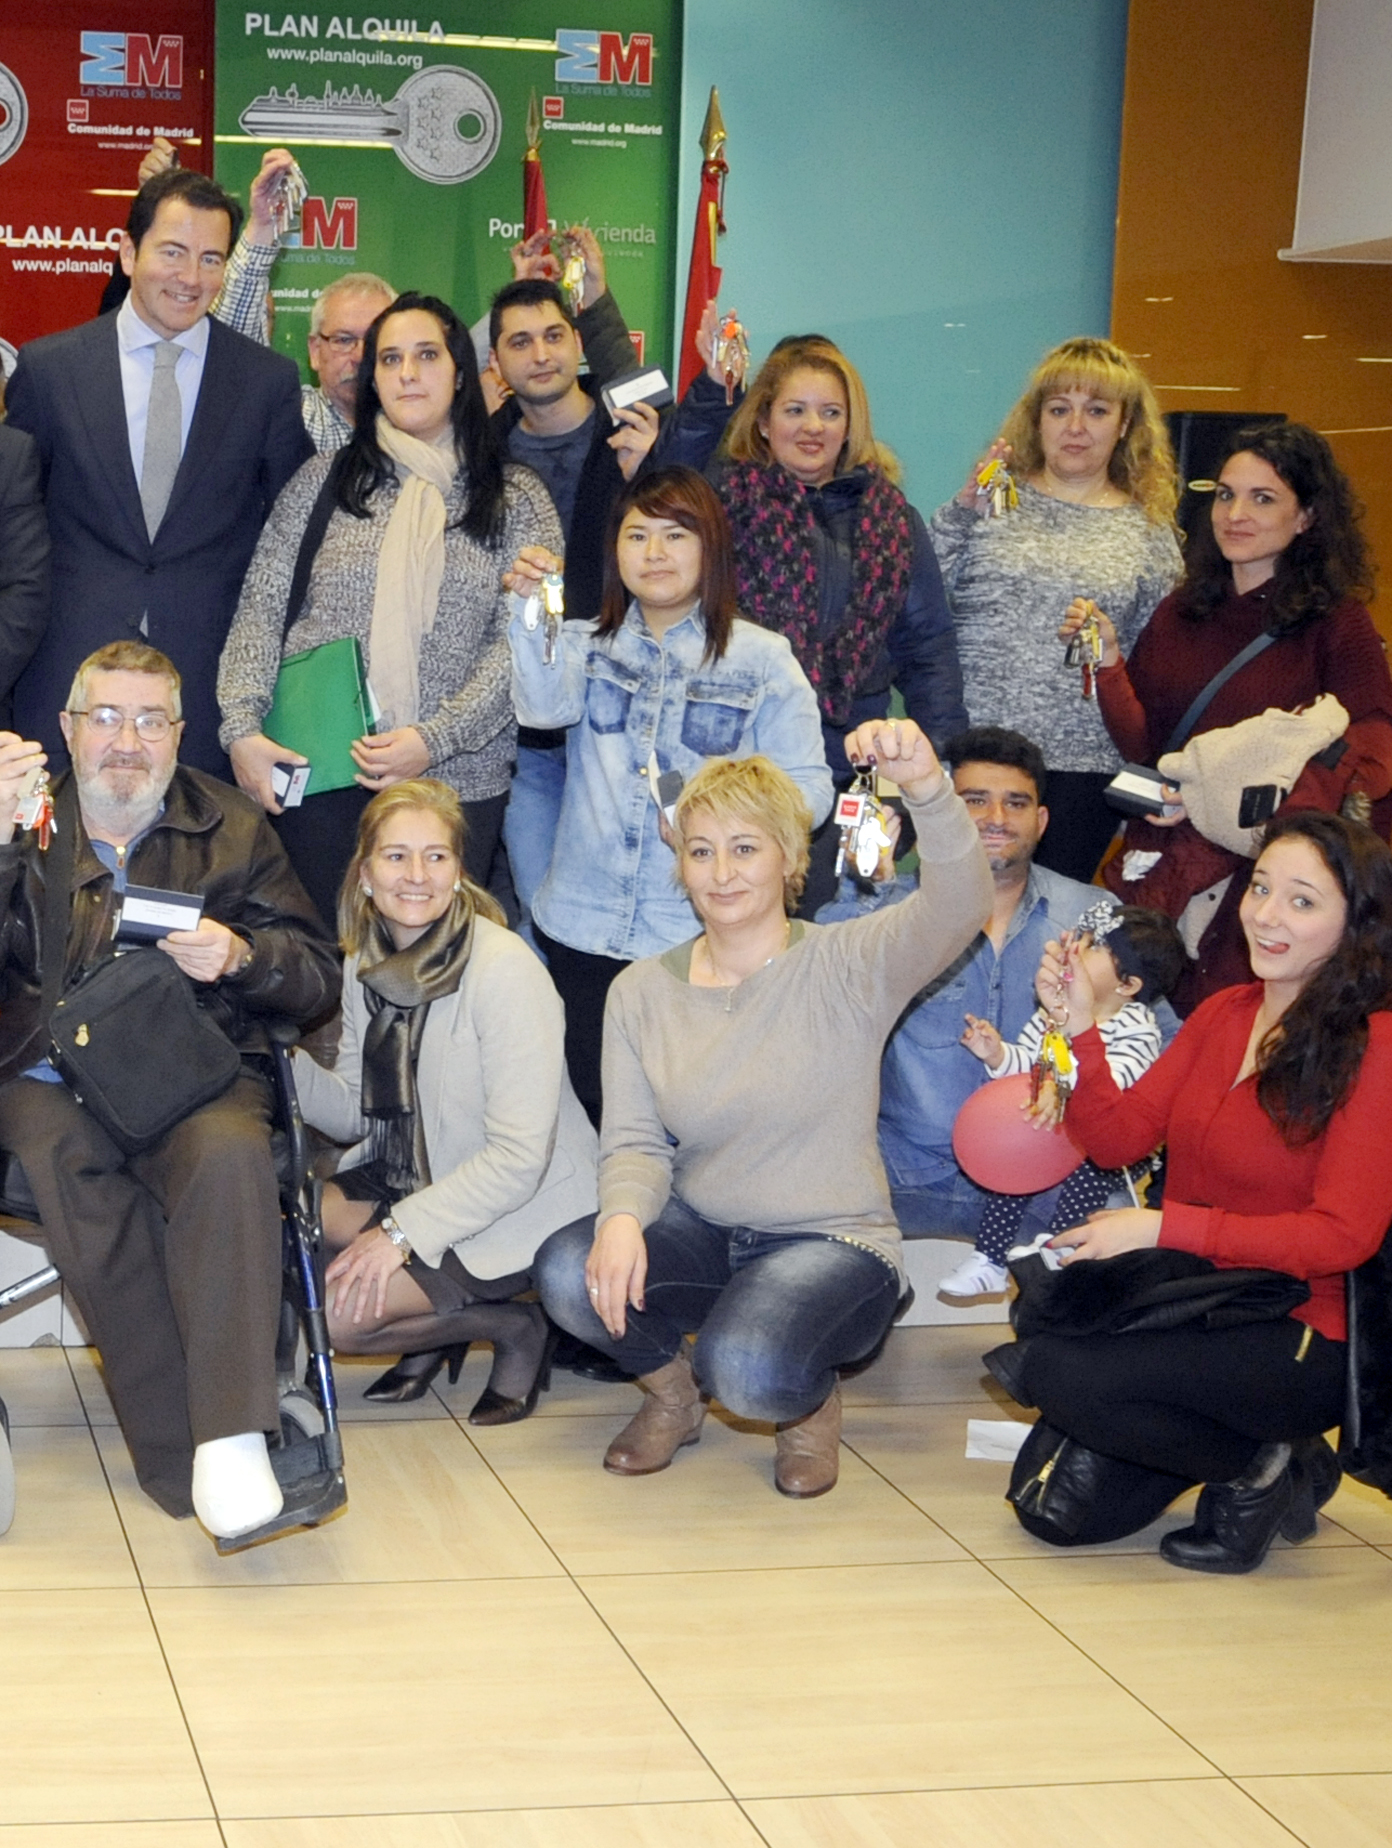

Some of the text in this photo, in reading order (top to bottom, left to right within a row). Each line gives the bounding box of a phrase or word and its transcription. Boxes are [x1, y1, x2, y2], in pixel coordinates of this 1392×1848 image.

[244, 12, 446, 43] PLAN ALQUILA
[266, 47, 424, 70] www.planalquila.org
[80, 85, 182, 100] La Suma de Todos
[67, 123, 194, 138] Comunidad de Madrid
[543, 120, 663, 136] Comunidad de Madrid
[97, 140, 154, 151] www.madrid.or
[12, 257, 113, 277] www.planalq
[270, 288, 309, 299] unidad
